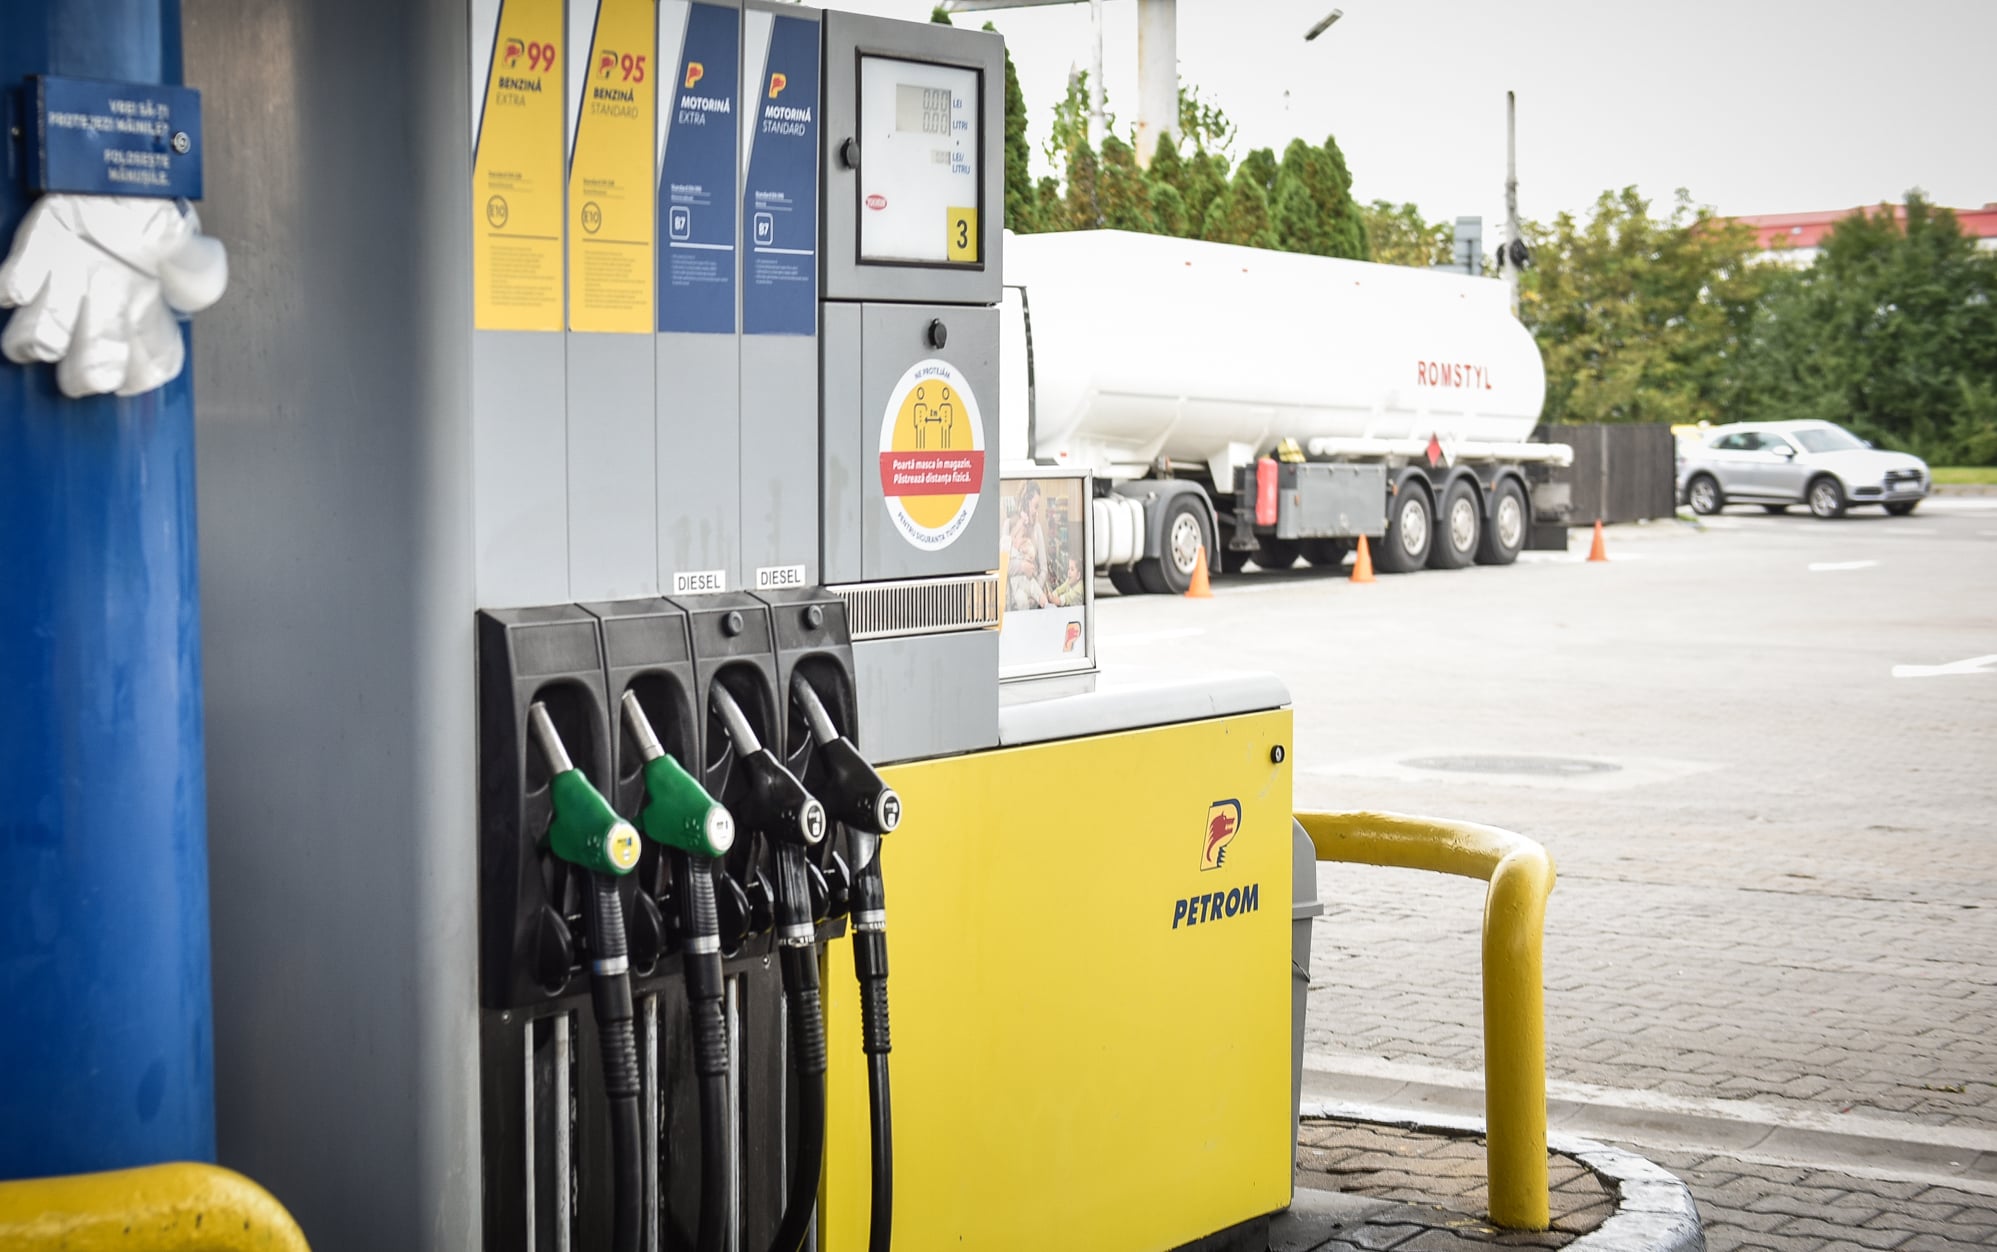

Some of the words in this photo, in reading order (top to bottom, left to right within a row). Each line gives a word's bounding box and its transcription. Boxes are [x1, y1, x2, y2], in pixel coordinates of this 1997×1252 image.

[528, 42, 556, 73] 99
[621, 53, 646, 83] 95
[496, 93, 526, 107] EXTRA
[953, 98, 962, 108] LEI
[591, 103, 639, 119] STANDARD
[678, 110, 706, 126] EXTRA
[762, 121, 805, 137] STANDARD
[956, 219, 968, 249] 3
[1417, 361, 1492, 390] ROMSTYL
[893, 458, 915, 470] Poartă
[916, 460, 936, 469] masca
[944, 458, 972, 471] magazin.
[678, 574, 721, 591] DIESEL
[761, 569, 801, 586] DIESEL
[1171, 883, 1259, 930] PETROM
